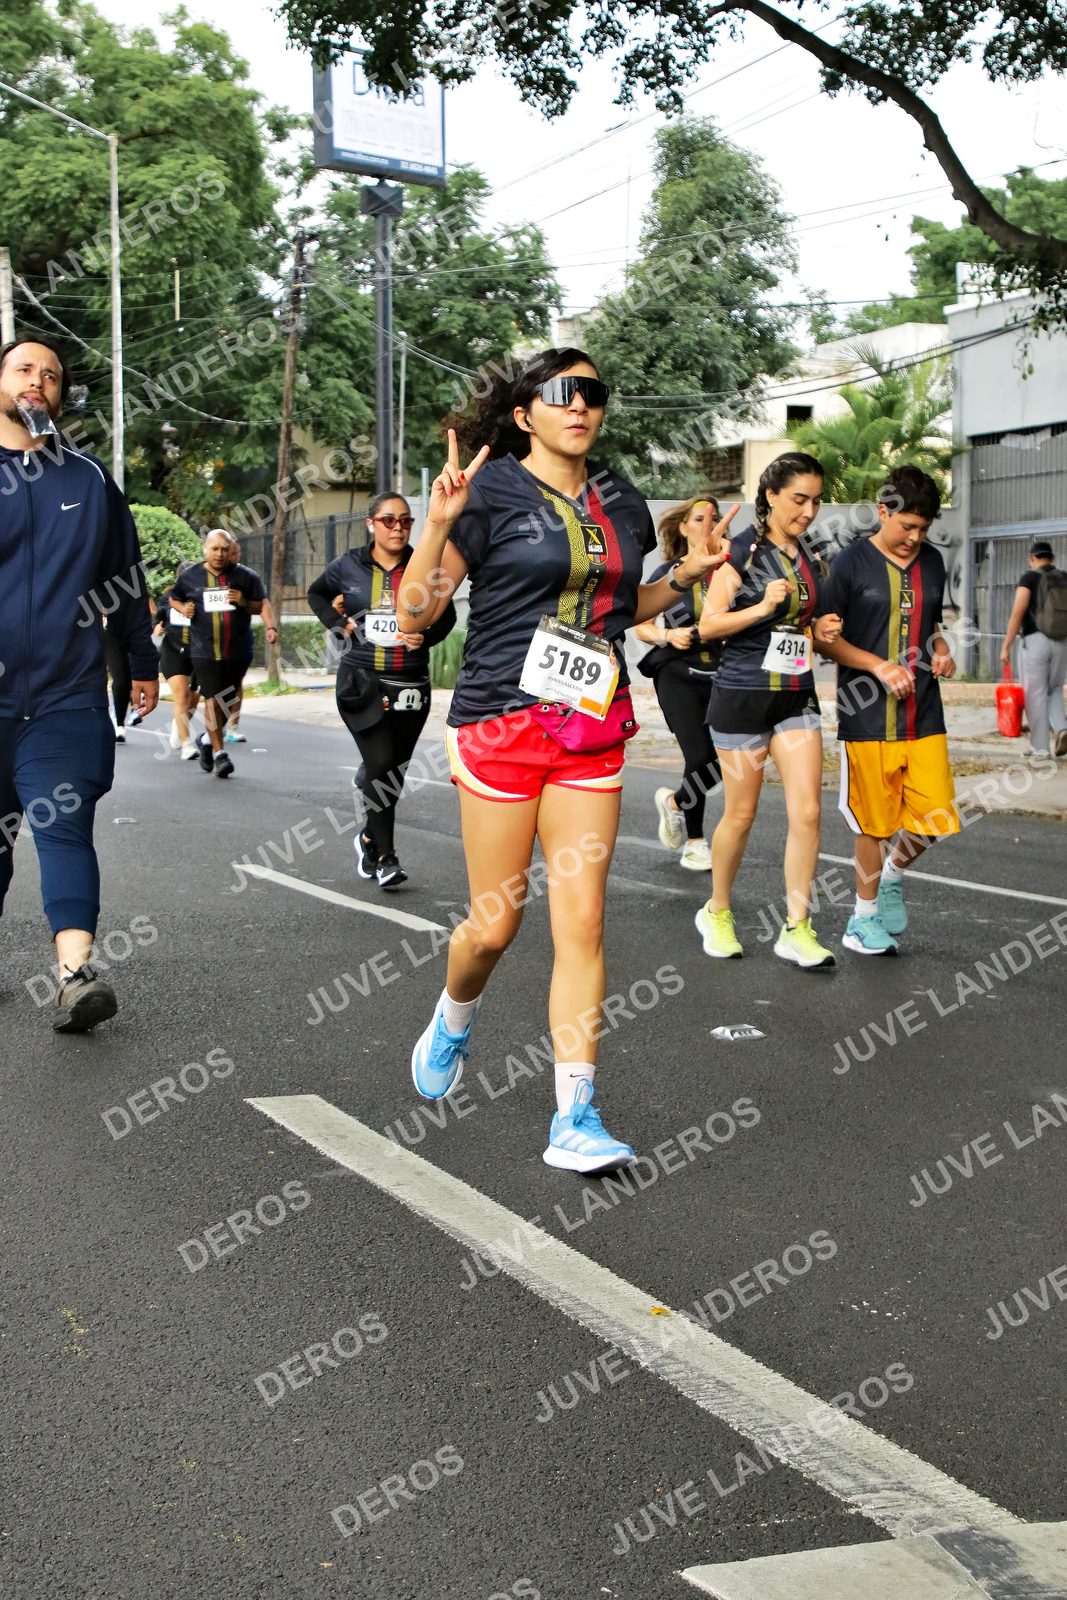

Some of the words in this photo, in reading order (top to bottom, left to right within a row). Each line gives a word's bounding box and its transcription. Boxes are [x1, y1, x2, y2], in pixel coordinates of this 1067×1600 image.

[372, 620, 400, 633] 420
[776, 639, 805, 657] 4314
[538, 644, 602, 686] 5189
